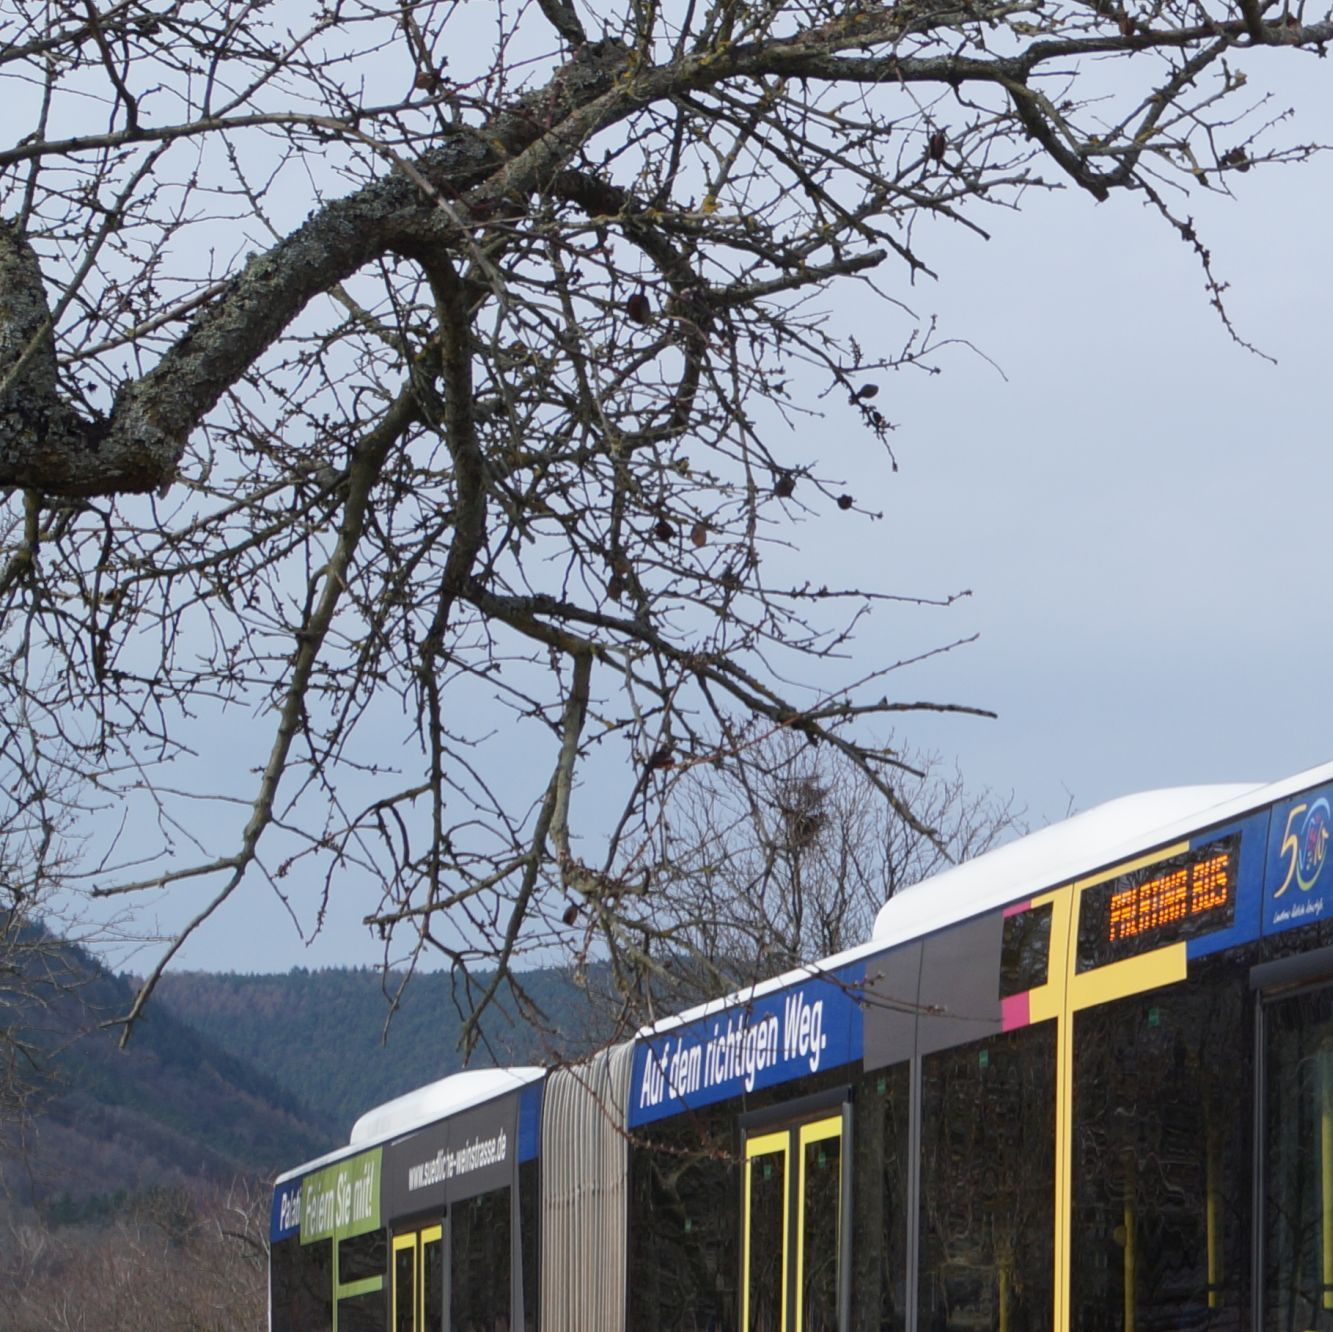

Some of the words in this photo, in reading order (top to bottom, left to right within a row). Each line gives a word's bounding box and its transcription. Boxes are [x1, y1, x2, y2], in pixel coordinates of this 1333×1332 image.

[1109, 869, 1188, 943] PALATINA
[1192, 854, 1229, 914] BUS
[640, 1042, 670, 1109] Auf
[669, 1037, 702, 1100] dem
[704, 1013, 779, 1093] richtigen
[784, 991, 827, 1073] Weg.
[304, 1181, 335, 1237] Feiern
[336, 1171, 352, 1228] Sie
[353, 1161, 375, 1222] mit!
